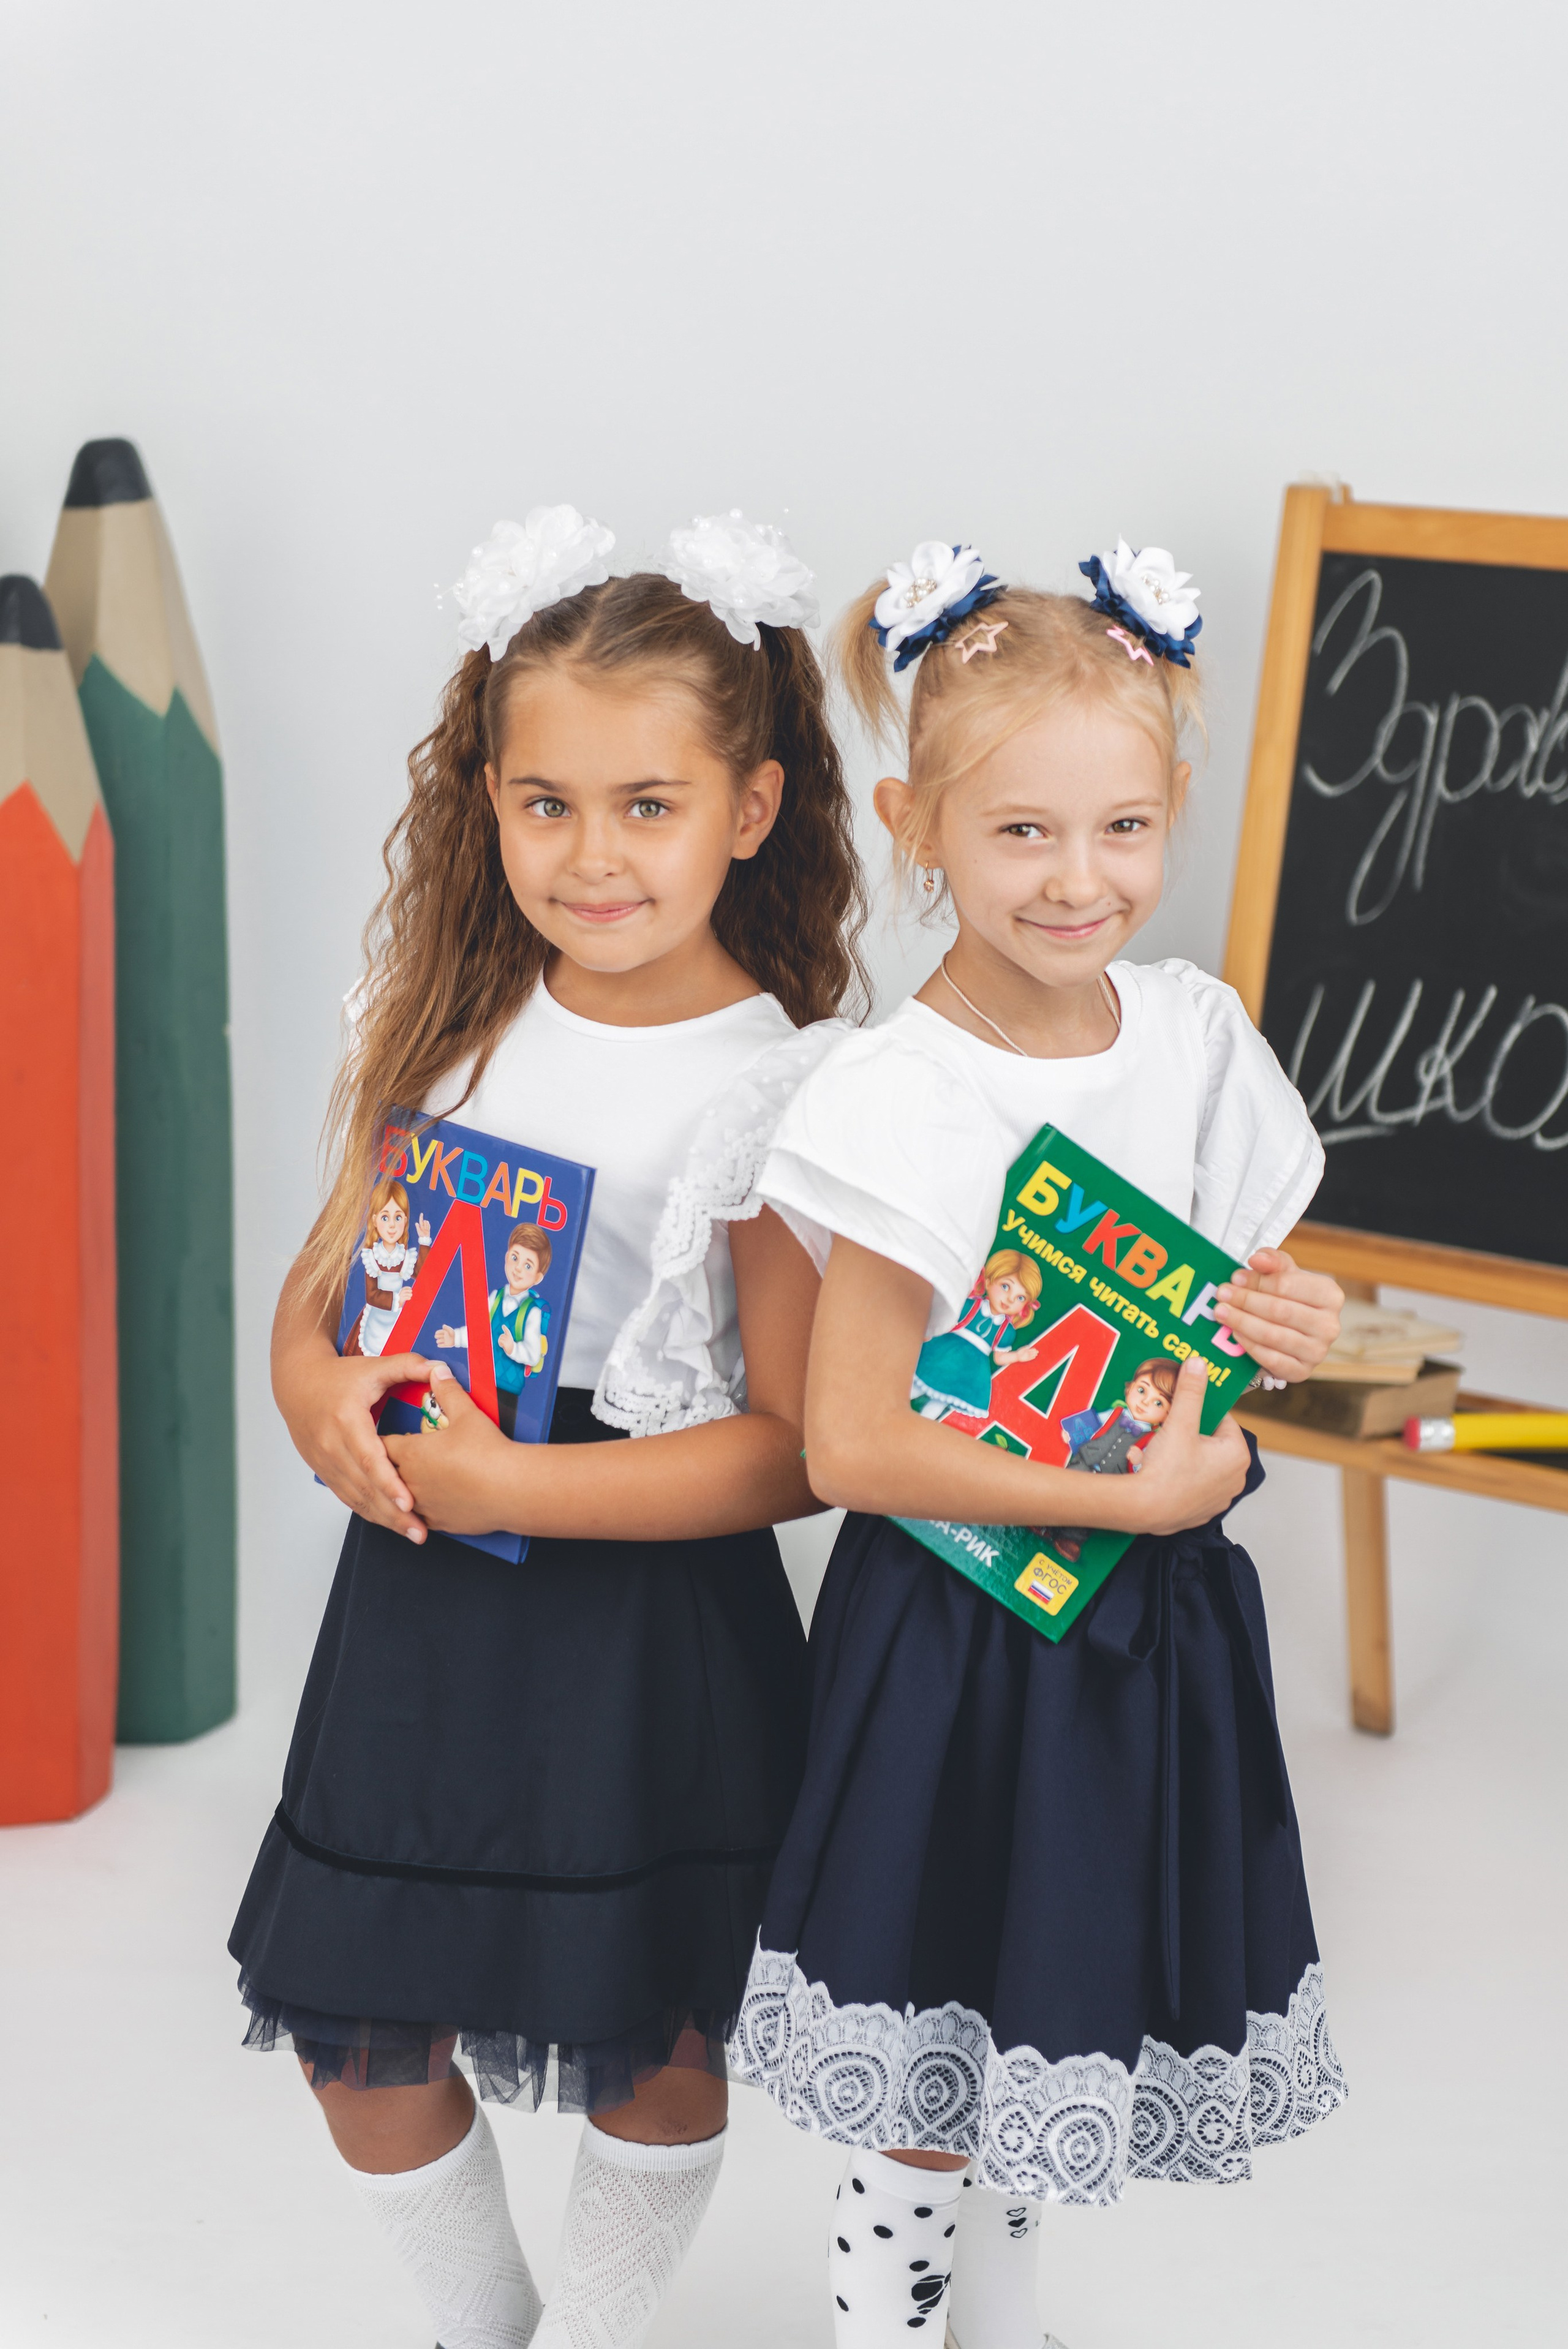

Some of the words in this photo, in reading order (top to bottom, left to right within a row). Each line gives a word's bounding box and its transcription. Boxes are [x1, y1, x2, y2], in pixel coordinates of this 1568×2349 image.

[379, 1125, 568, 1232] БУКВАРЬ
[1001, 1208, 1088, 1284] Учимся
[1089, 1276, 1159, 1339] читать
[929, 1520, 1000, 1567] А-РИК
[1033, 1566, 1068, 1595] ФГОС
